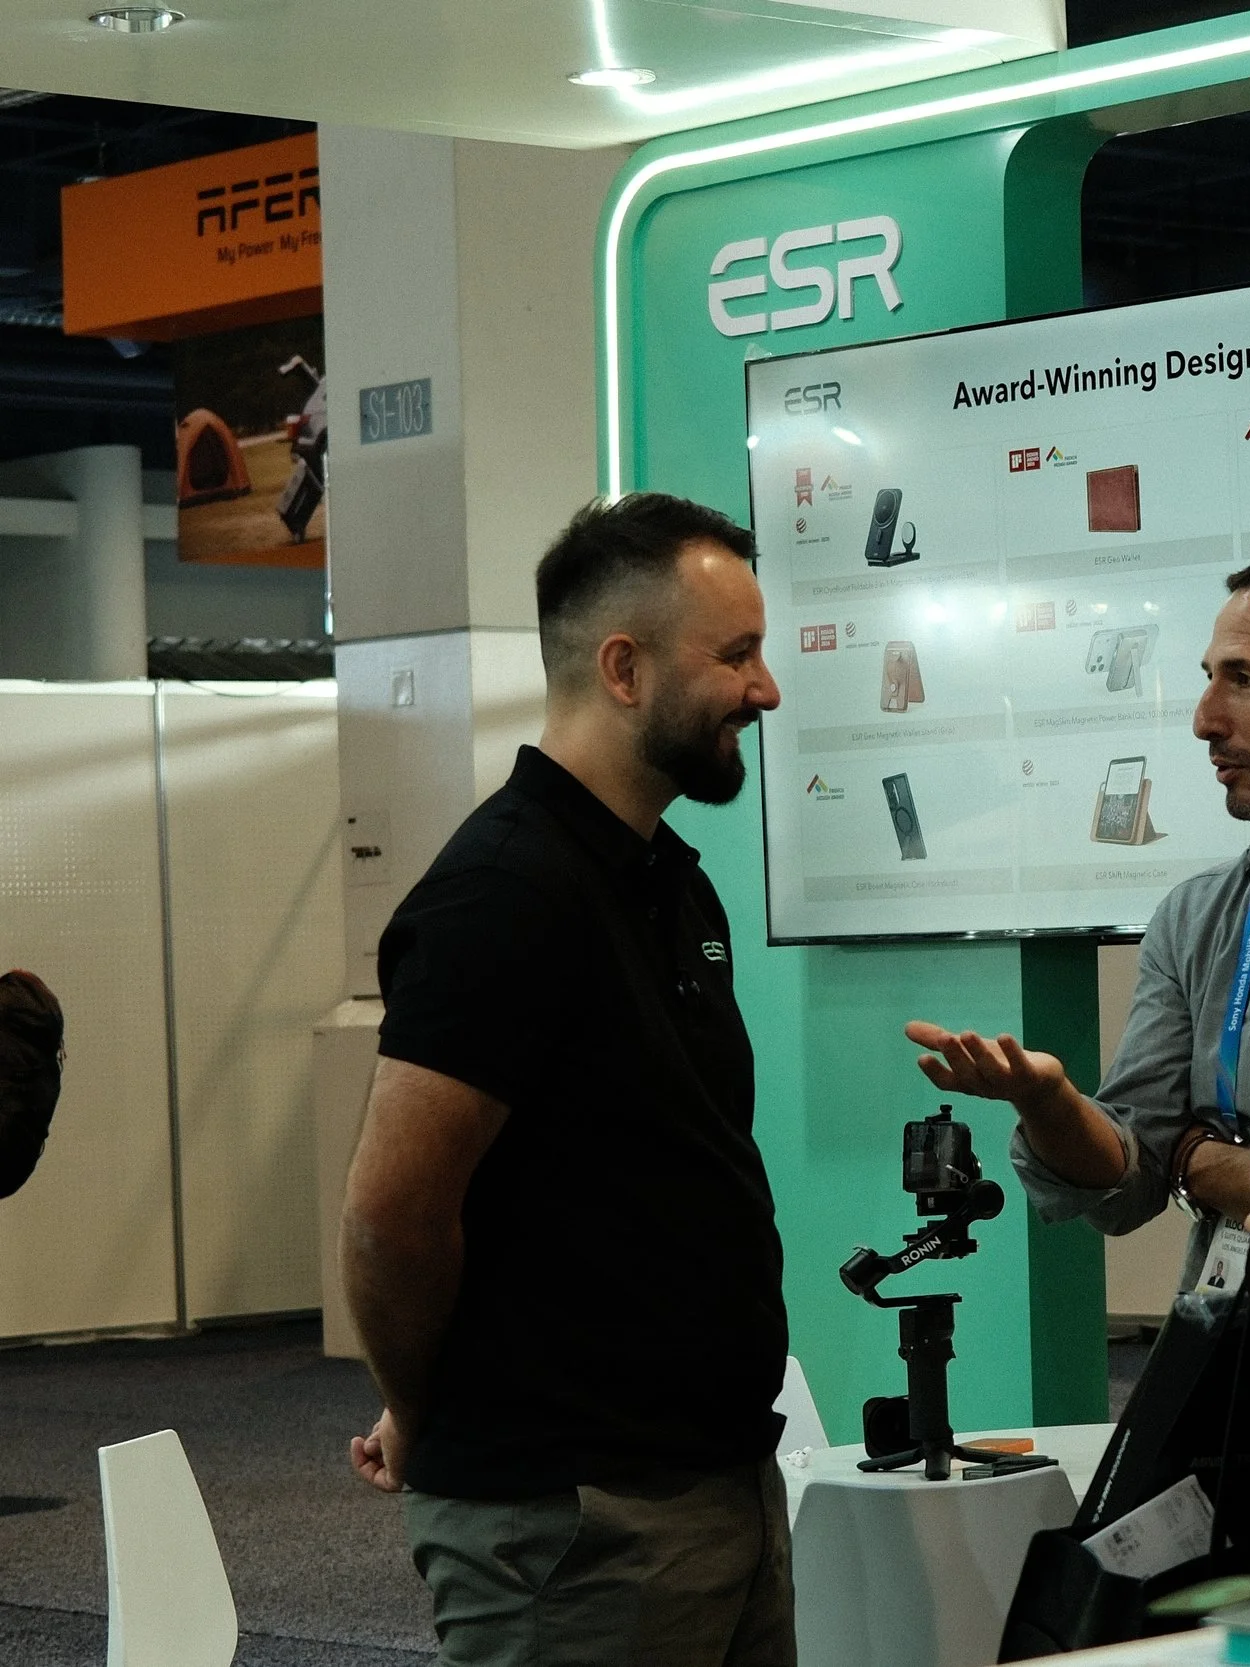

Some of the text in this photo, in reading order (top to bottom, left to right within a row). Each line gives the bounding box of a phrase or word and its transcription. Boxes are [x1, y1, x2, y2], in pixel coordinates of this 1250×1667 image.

[217, 247, 236, 265] My
[239, 241, 274, 258] Power
[280, 234, 299, 253] My
[708, 215, 903, 337] ESR
[784, 381, 842, 417] ESR
[953, 357, 1157, 410] Award-Winning
[1234, 973, 1248, 1006] Honda
[1229, 1007, 1242, 1032] Sony
[900, 1236, 942, 1267] RONIN
